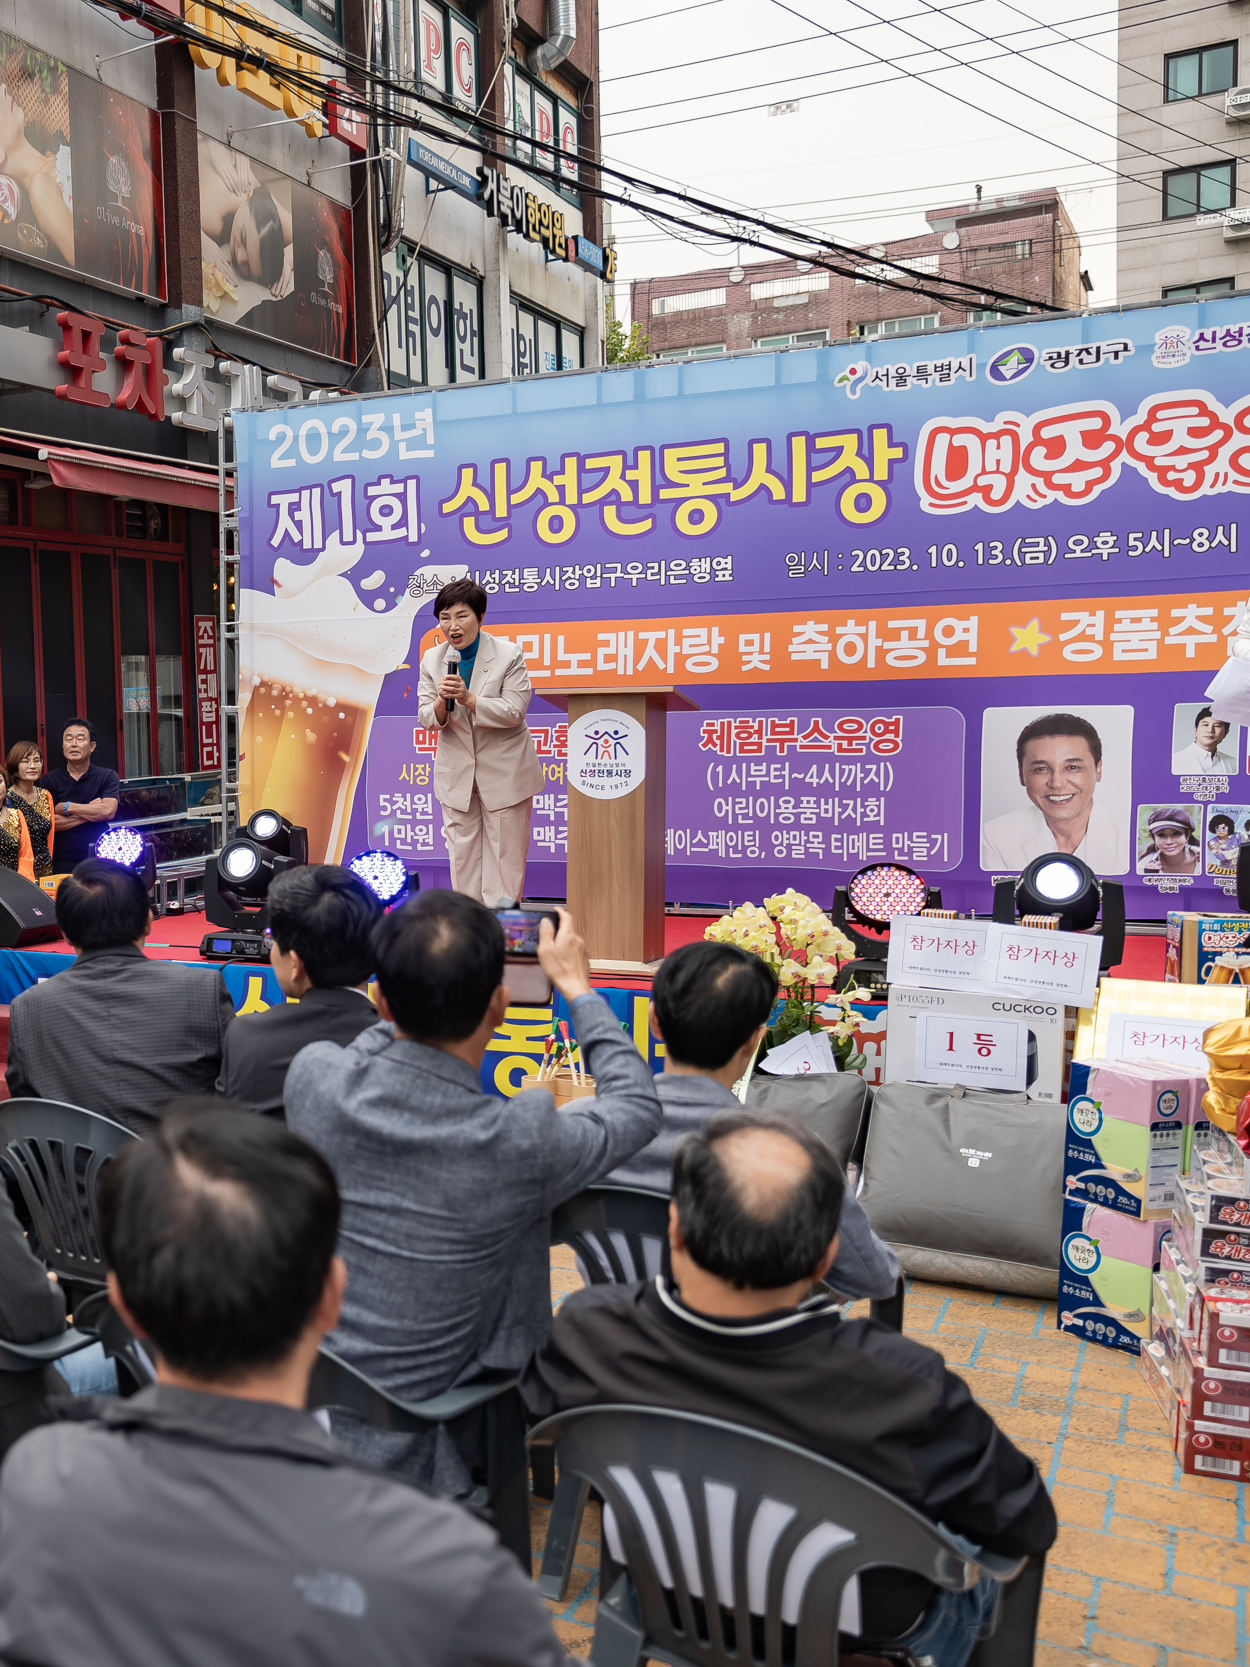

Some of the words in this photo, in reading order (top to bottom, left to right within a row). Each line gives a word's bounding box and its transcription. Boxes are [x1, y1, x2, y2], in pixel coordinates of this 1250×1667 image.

[418, 147, 438, 168] KOREAN
[438, 158, 457, 182] MEDICAL
[457, 171, 472, 189] CLINIC
[96, 206, 120, 227] Olive
[121, 218, 145, 236] Aroma
[483, 166, 566, 259] 거북이한의원
[605, 247, 617, 280] 2F
[310, 292, 327, 306] Olive
[327, 298, 343, 314] Aroma
[870, 356, 975, 389] 서울특별시
[1042, 342, 1132, 371] 광진구
[1192, 325, 1250, 352] 신성
[268, 408, 436, 469] 2023년
[268, 476, 420, 549] 제1회
[440, 426, 905, 547] 신성전통시장
[785, 550, 830, 578] 일시
[850, 546, 919, 573] 2023.
[927, 542, 966, 569] 10.
[974, 534, 1058, 567] 13.(금)
[1064, 530, 1120, 561] 오후
[1126, 522, 1239, 558] 5시~8시
[406, 572, 444, 599] 장소
[495, 624, 725, 678] 민노래자랑
[738, 632, 772, 672] 및
[787, 615, 980, 669] 축하공연
[700, 715, 903, 756] 체험부스운영
[399, 763, 431, 785] 시장
[579, 768, 632, 778] 신성전통시장
[581, 780, 605, 791] SINCE
[609, 780, 629, 791] 1972
[379, 793, 434, 820] 5천원
[713, 796, 886, 826] 어린이용품바자회
[380, 823, 434, 851] 1만원
[771, 831, 826, 859] 양말목
[892, 832, 949, 862] 만들기
[909, 933, 979, 957] 참가자상
[1004, 943, 1079, 969] 참가자상
[991, 1001, 1058, 1016] CUCKOO
[1076, 1107, 1097, 1120] 깨끗한
[1078, 1117, 1093, 1128] 나라
[1067, 1149, 1096, 1164] 순수소프티
[1070, 1243, 1095, 1258] 깨끗한
[1074, 1254, 1090, 1266] 나라
[1062, 1284, 1093, 1301] 순수소프티
